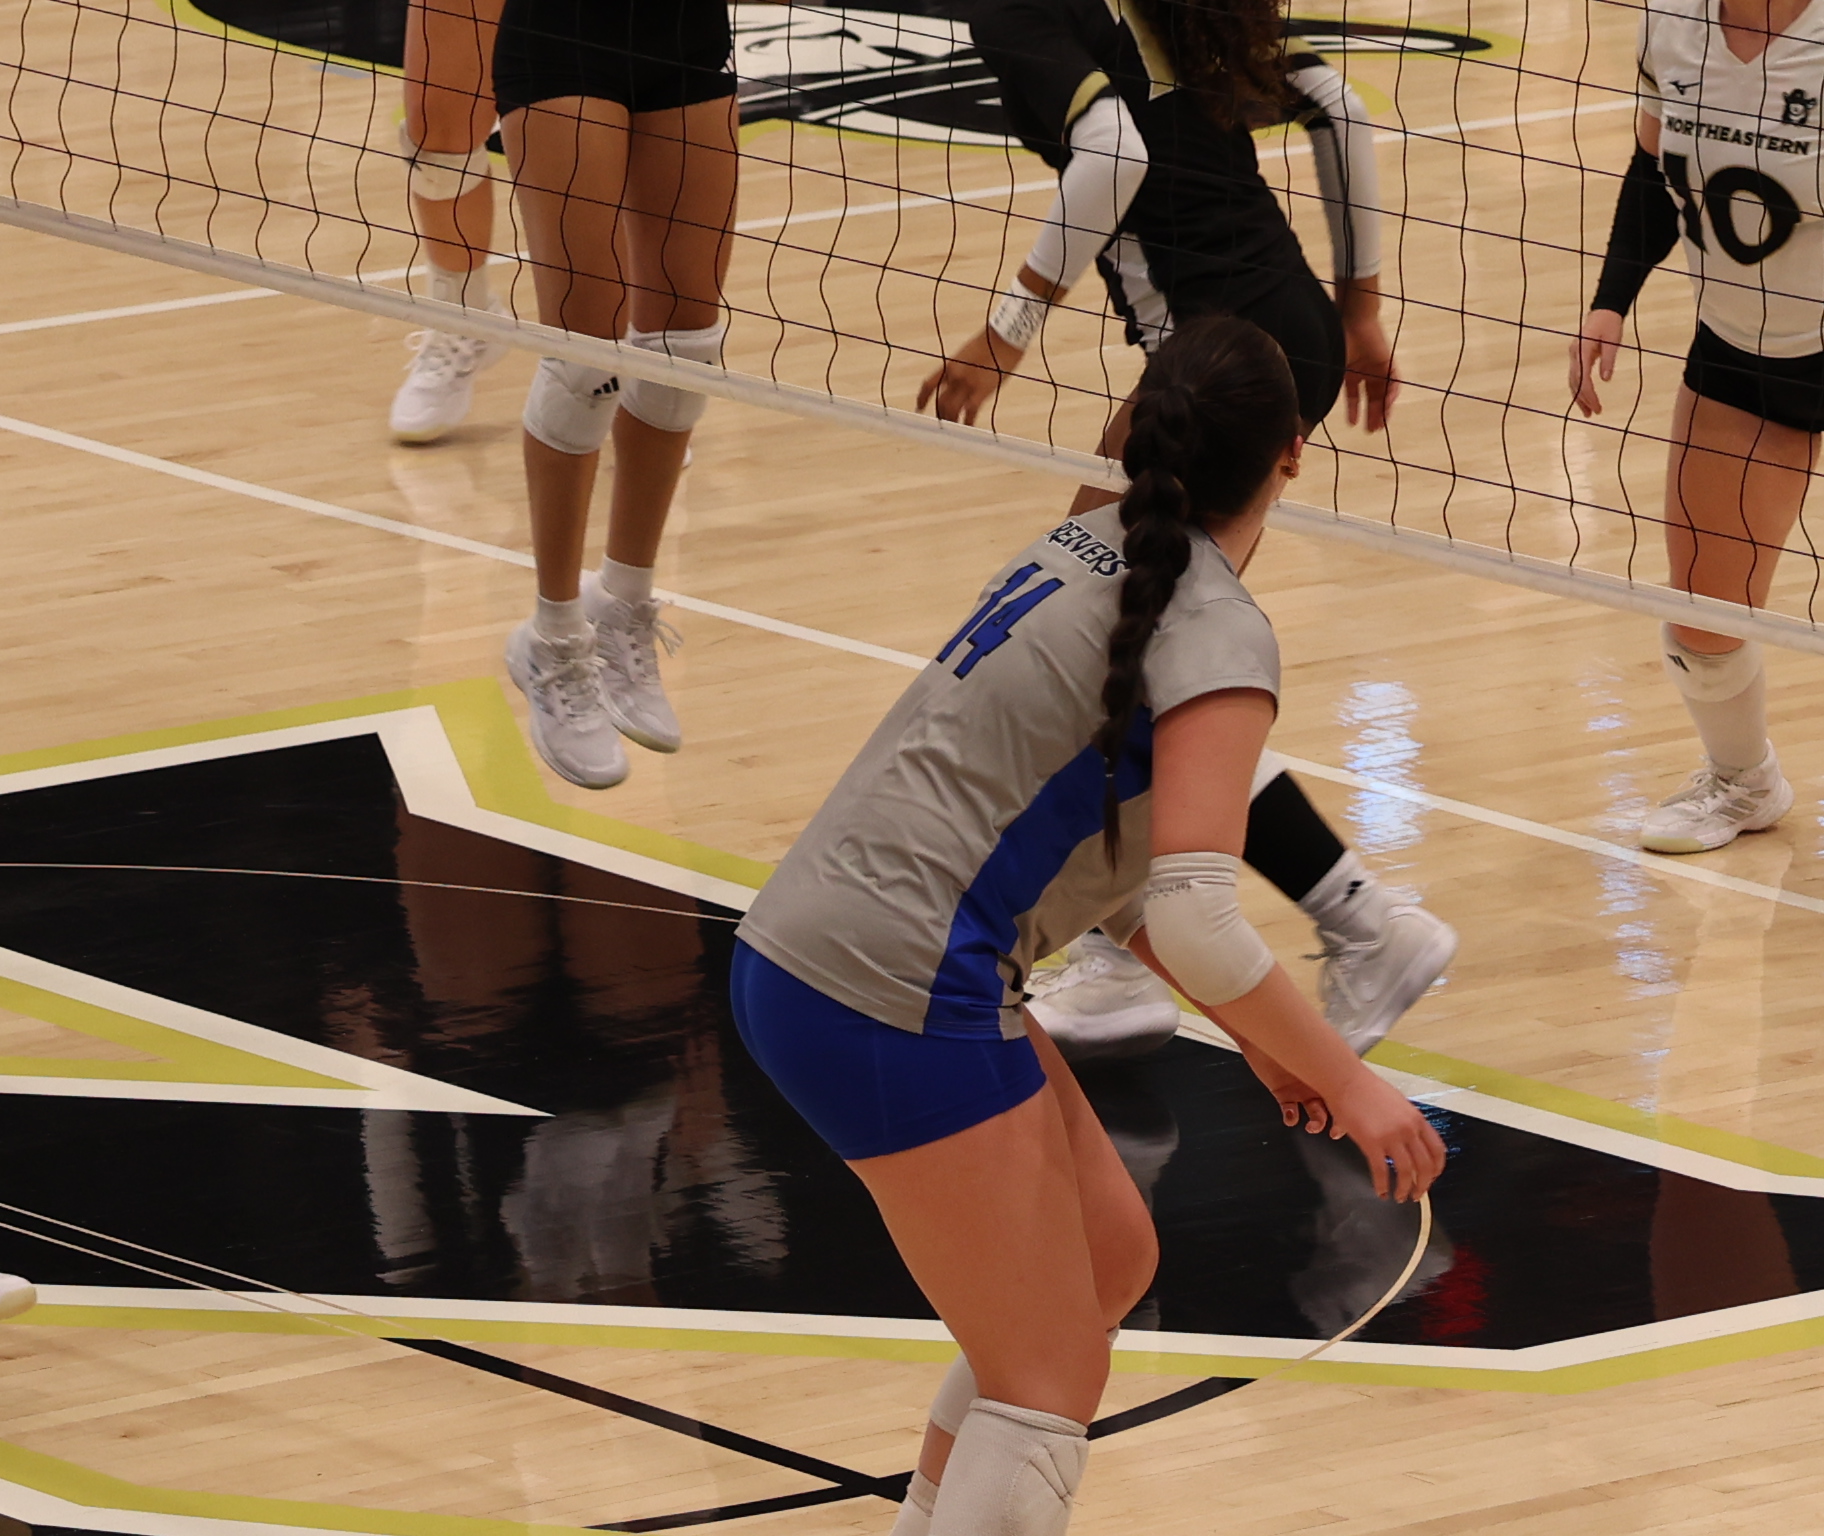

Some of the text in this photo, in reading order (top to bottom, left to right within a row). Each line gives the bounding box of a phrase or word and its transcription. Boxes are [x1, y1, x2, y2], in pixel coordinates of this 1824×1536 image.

[1665, 115, 1811, 156] NORTHEASTERN
[1662, 150, 1803, 267] 10
[1046, 520, 1128, 579] REIVERS
[935, 561, 1067, 680] 14
